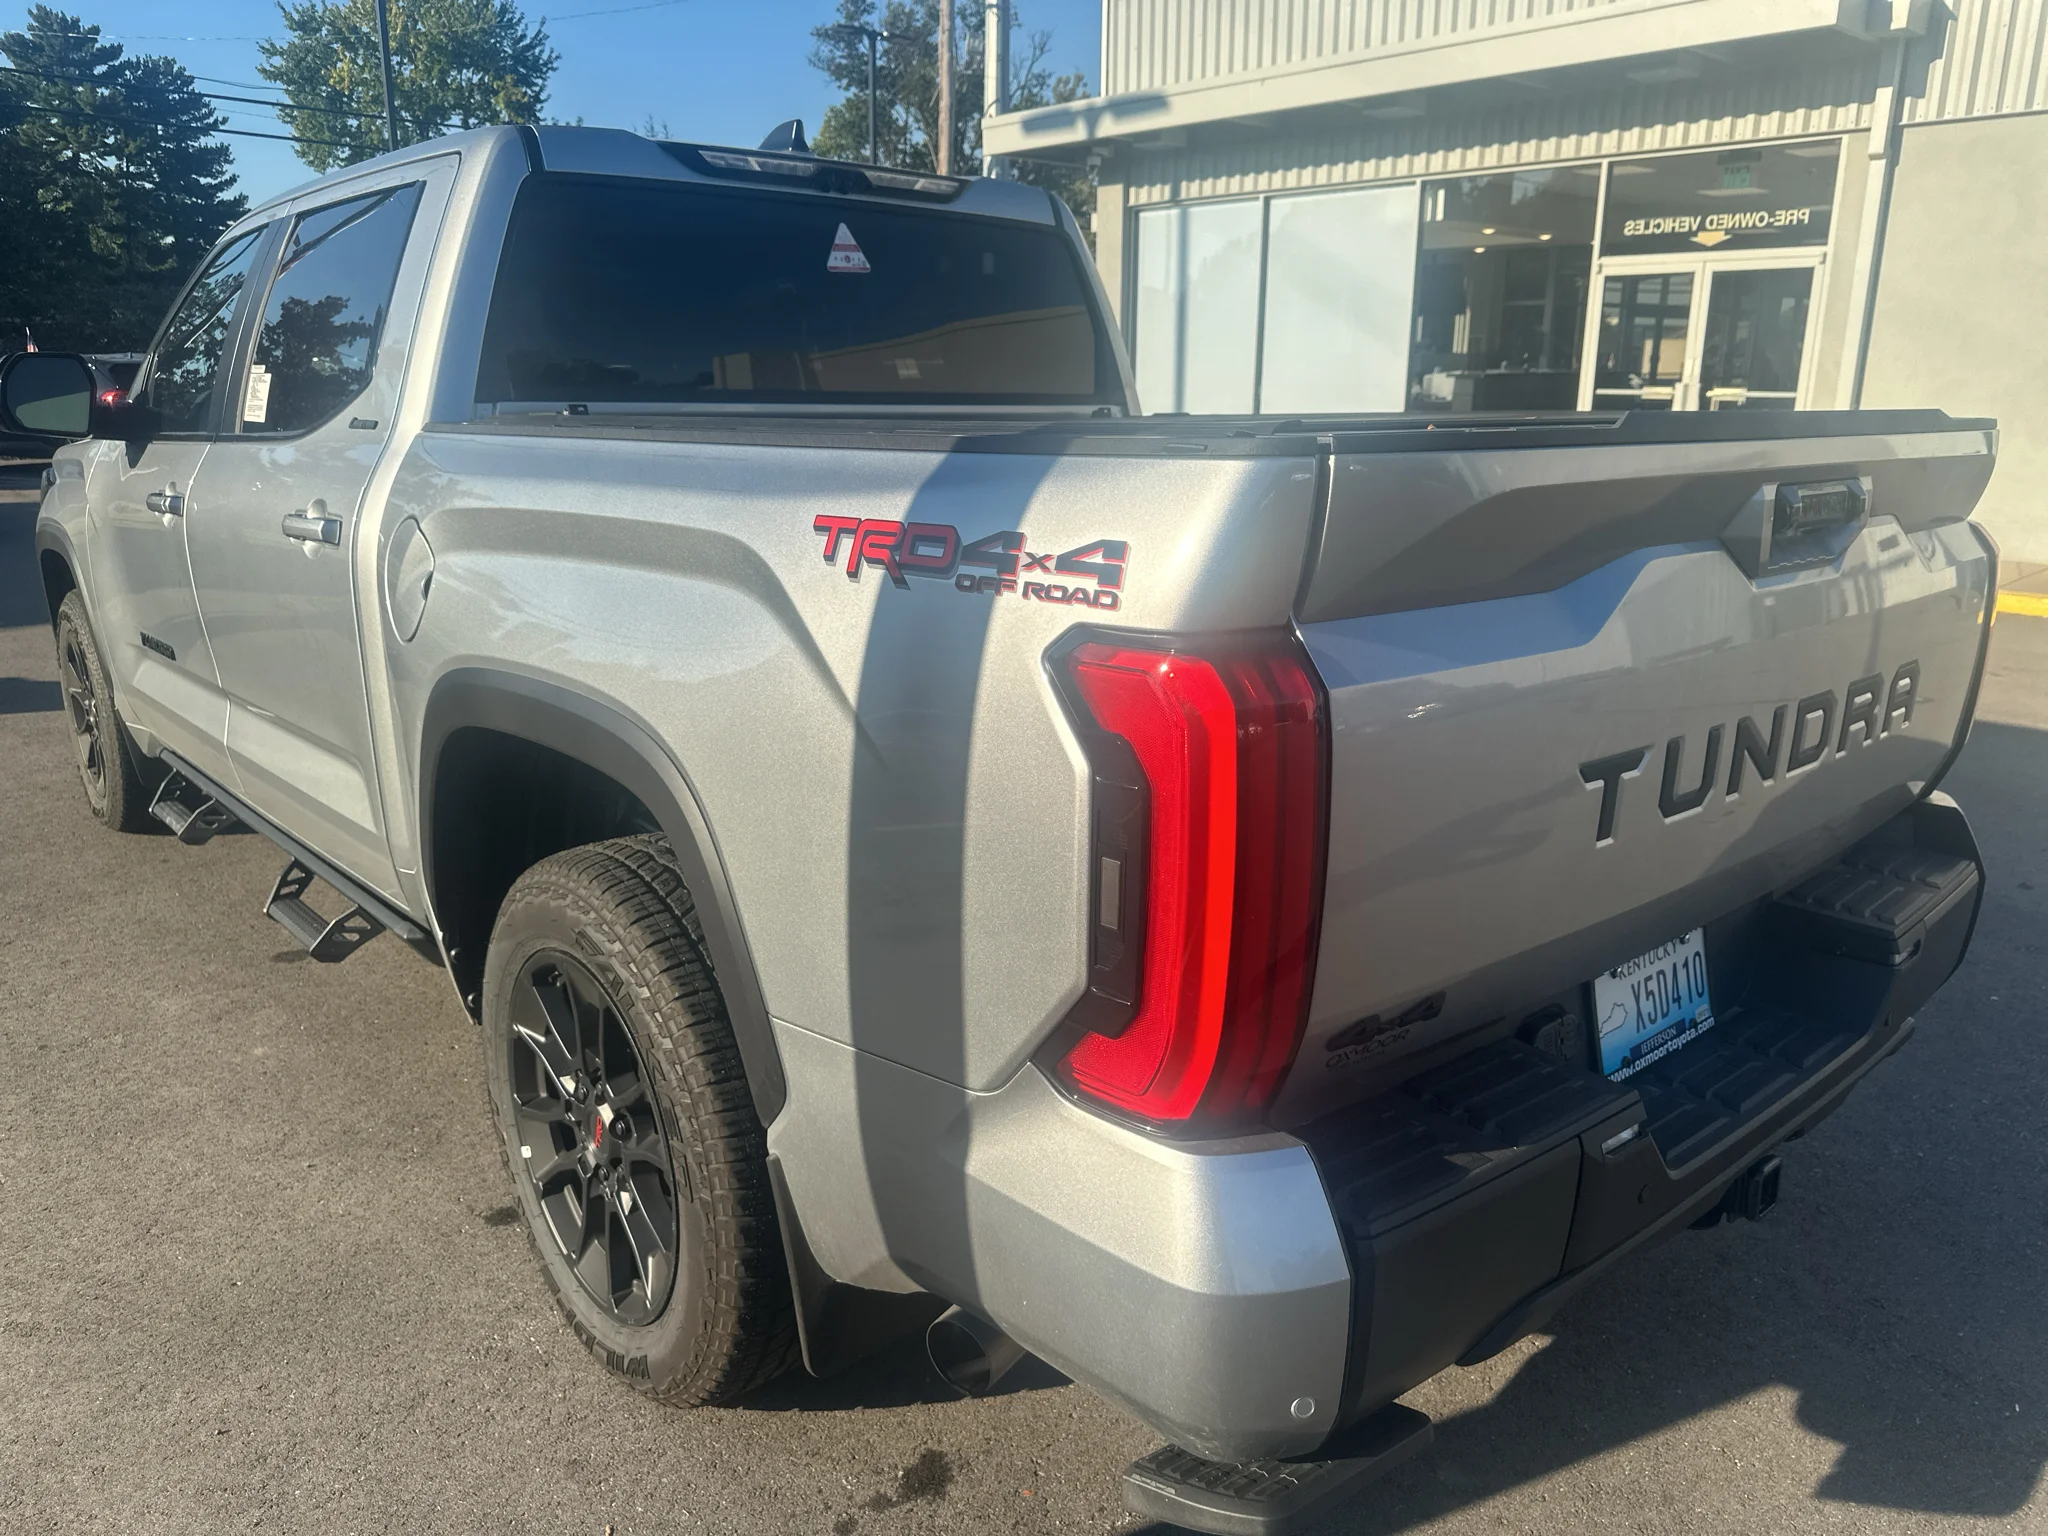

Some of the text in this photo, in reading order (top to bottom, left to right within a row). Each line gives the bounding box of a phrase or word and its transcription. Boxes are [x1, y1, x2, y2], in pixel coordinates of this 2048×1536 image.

[812, 514, 963, 590] TRD
[955, 573, 1123, 611] OFF ROAD
[1577, 658, 1921, 848] TUNDRA
[1617, 937, 1678, 981] KENTUCKY
[1630, 950, 1705, 1034] X5D410
[1640, 1026, 1678, 1054] JEFFERSON
